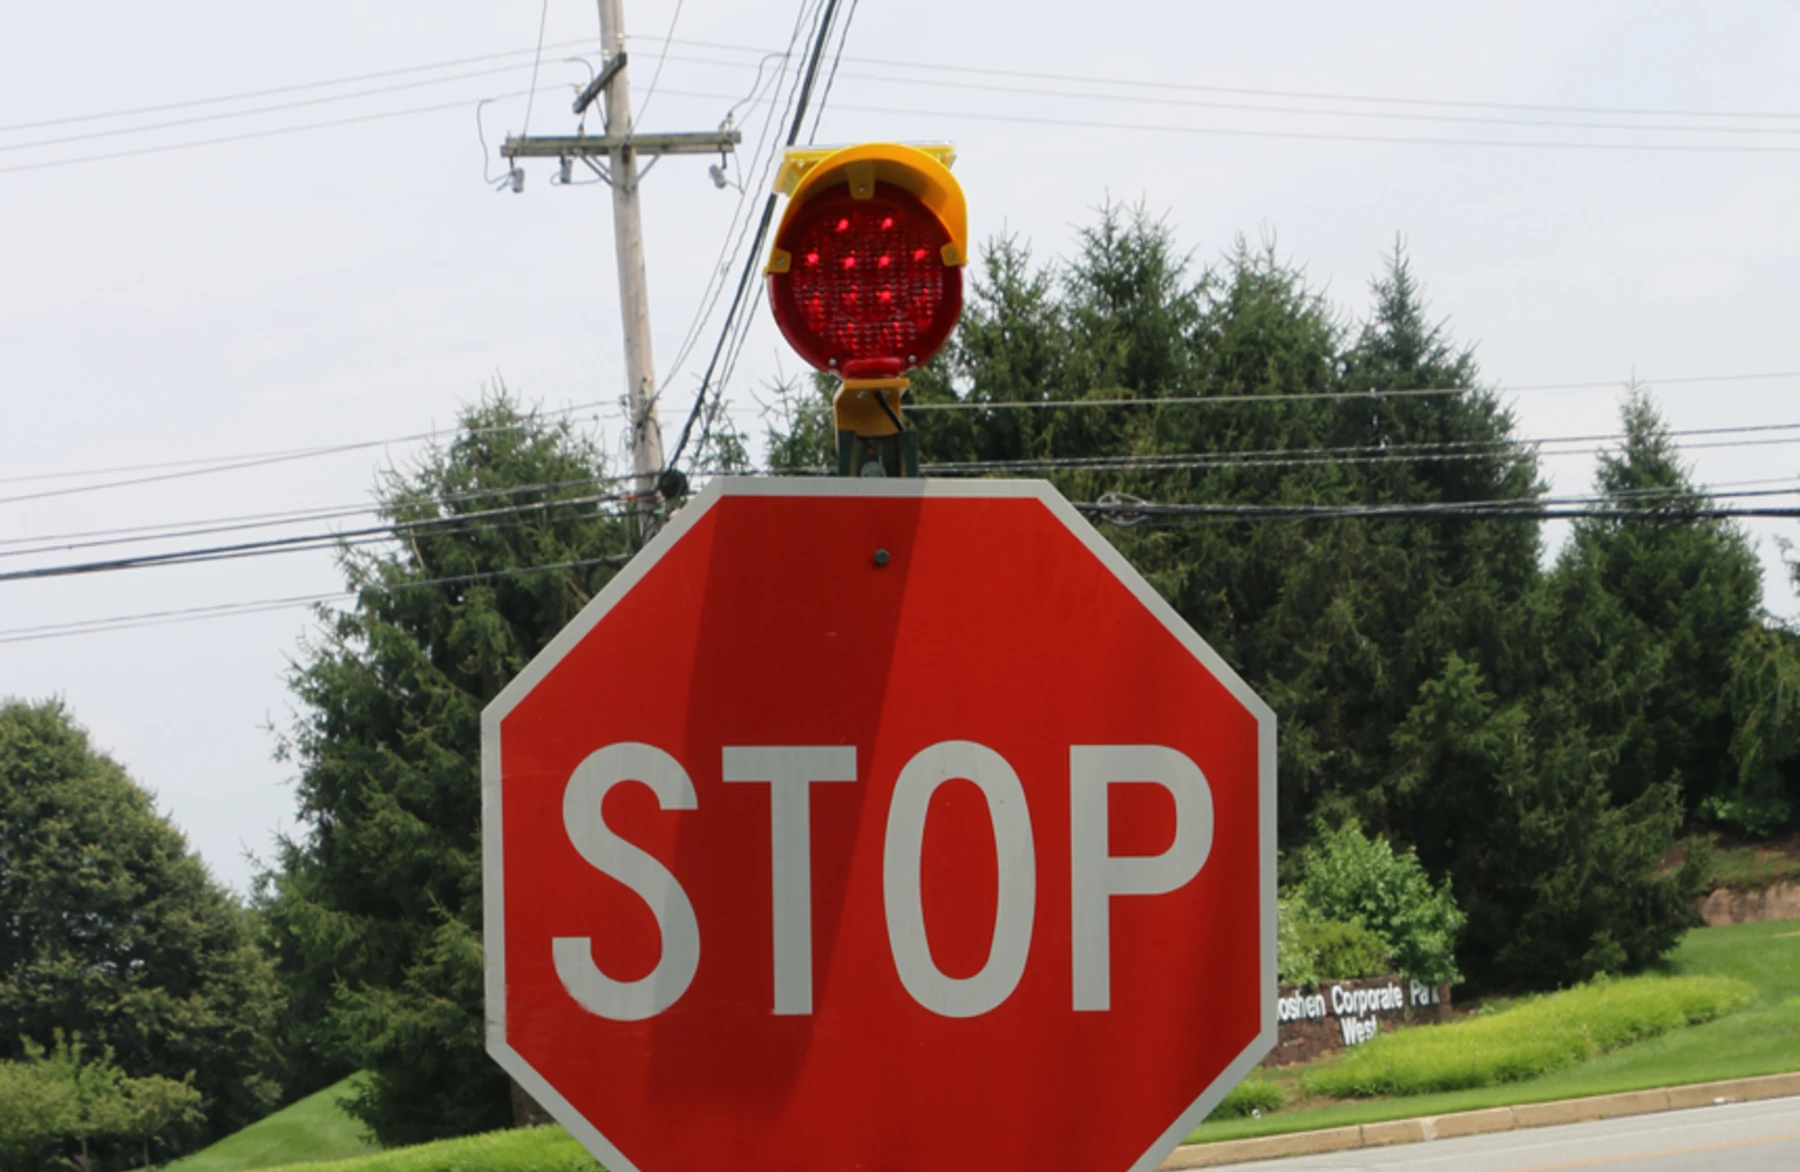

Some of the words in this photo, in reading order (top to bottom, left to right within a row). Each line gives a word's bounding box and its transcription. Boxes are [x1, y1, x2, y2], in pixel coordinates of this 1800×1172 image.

[552, 740, 1214, 1021] STOP
[1277, 989, 1326, 1020] oshen
[1331, 982, 1403, 1017] Corporate
[1340, 1015, 1377, 1045] West
